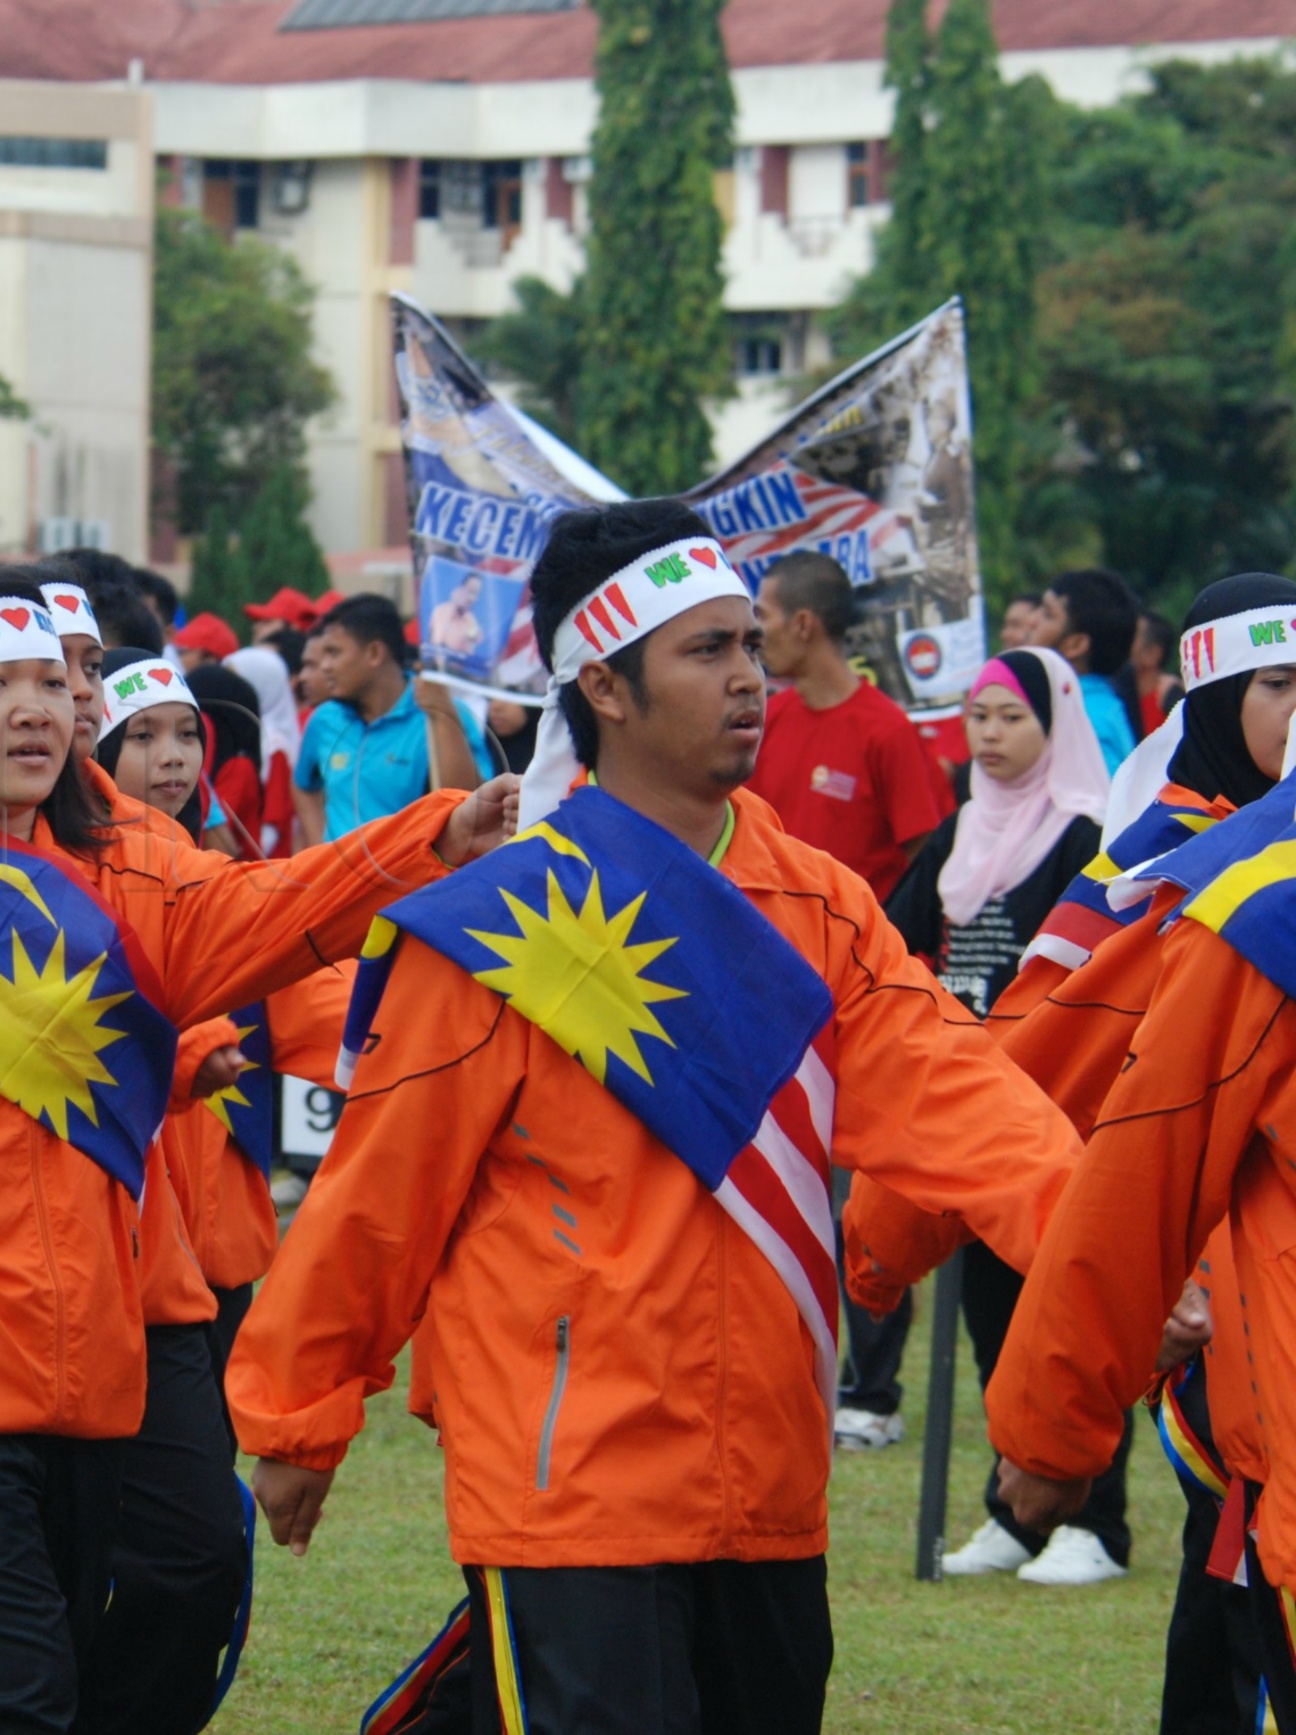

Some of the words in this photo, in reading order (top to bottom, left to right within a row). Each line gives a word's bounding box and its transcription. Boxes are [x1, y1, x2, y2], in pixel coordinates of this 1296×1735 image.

[414, 485, 553, 562] KECEM
[644, 553, 692, 589] WE
[1248, 619, 1287, 647] WE
[113, 671, 148, 700] WE
